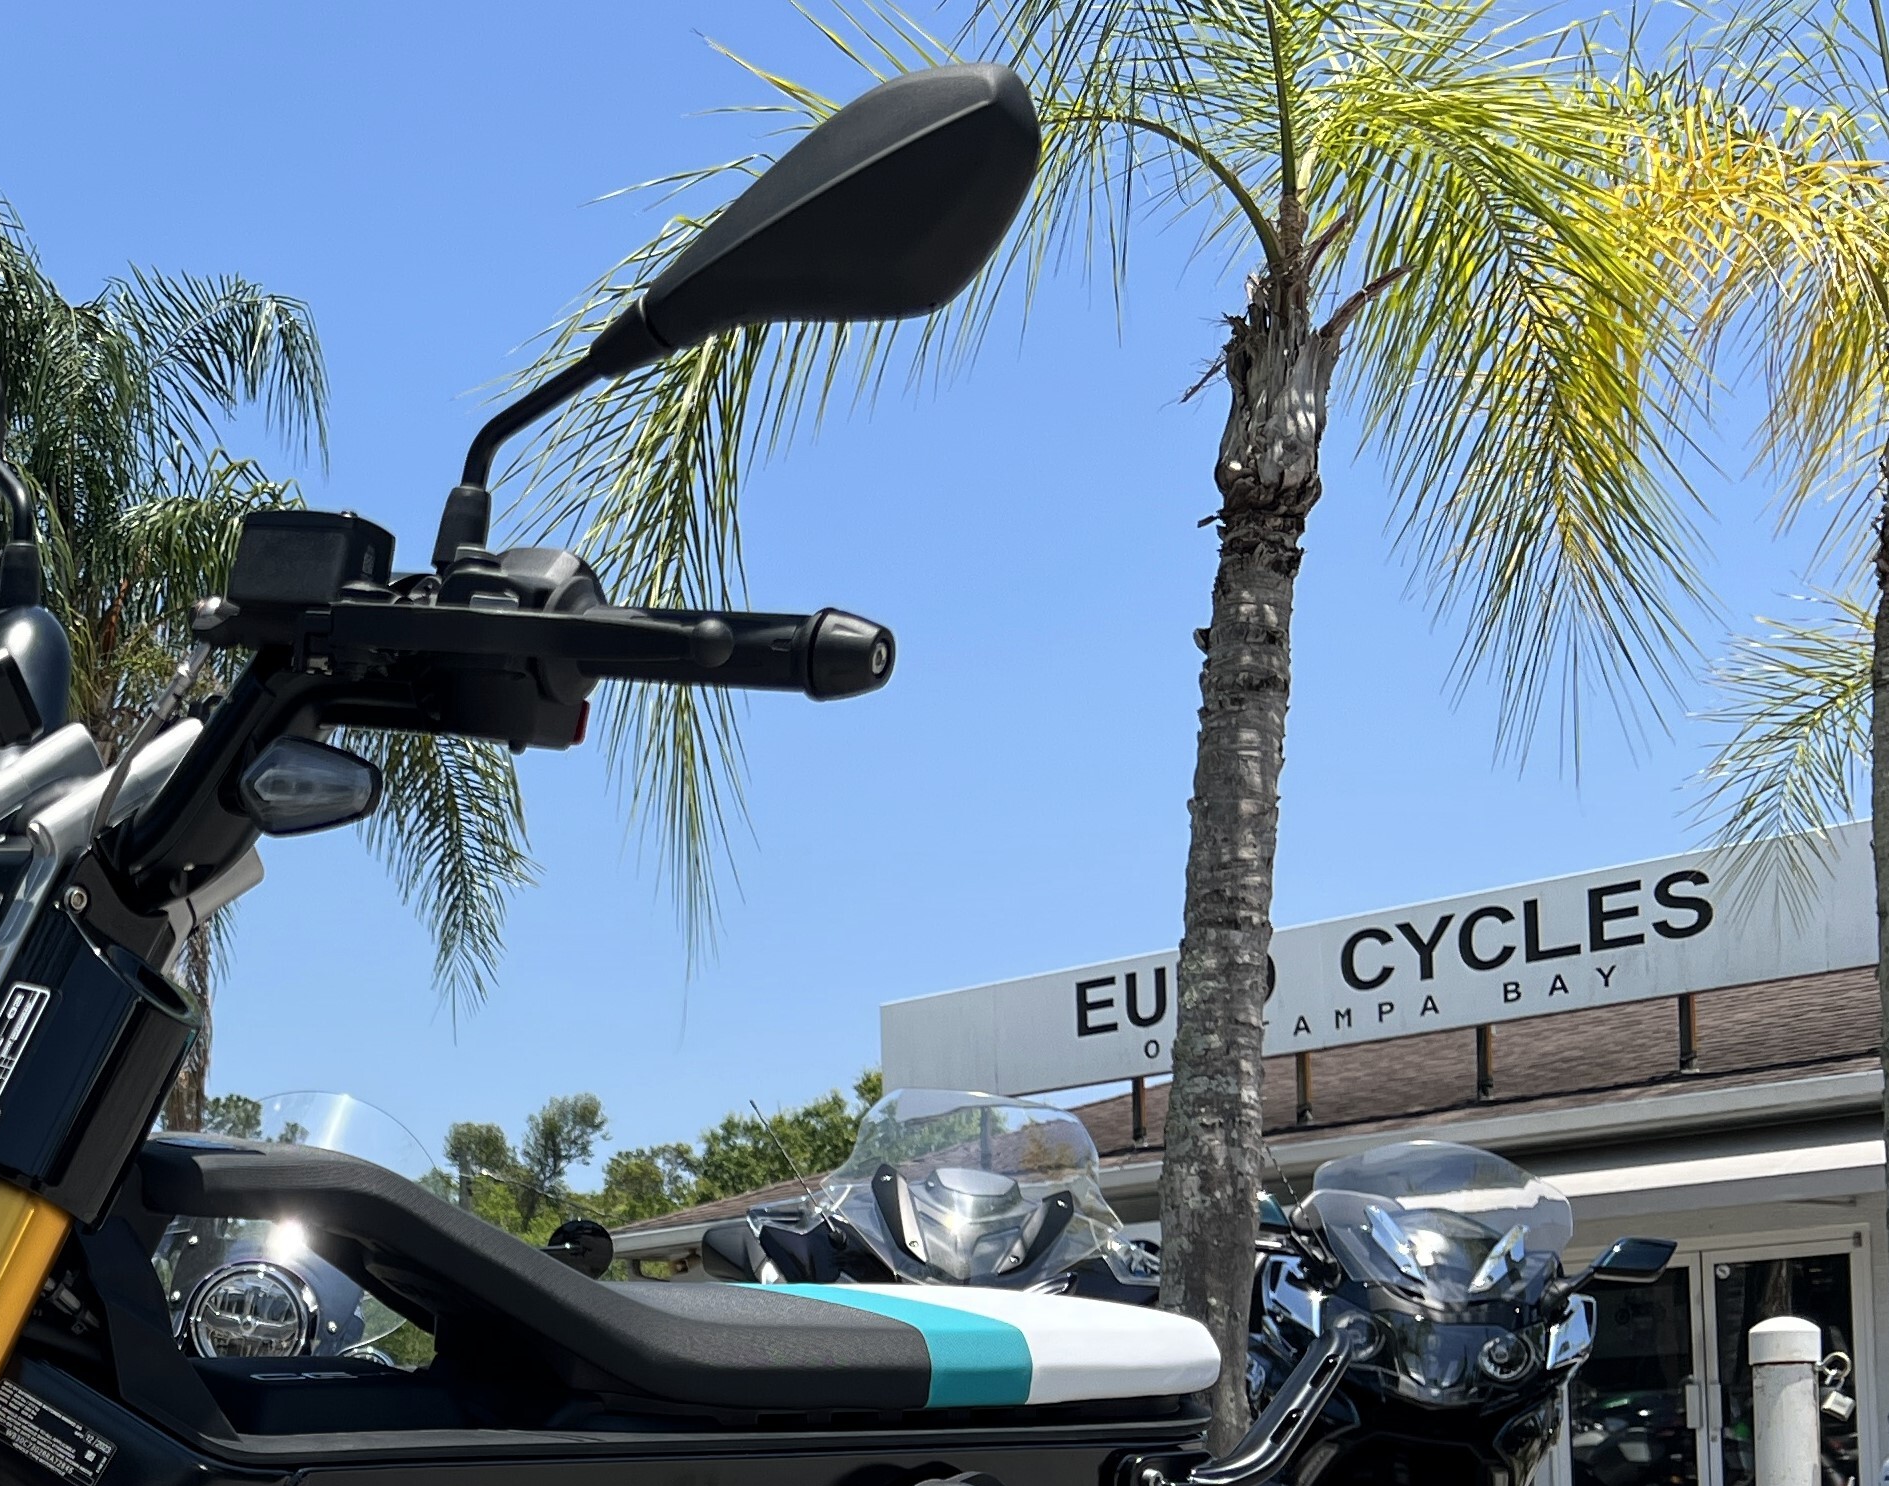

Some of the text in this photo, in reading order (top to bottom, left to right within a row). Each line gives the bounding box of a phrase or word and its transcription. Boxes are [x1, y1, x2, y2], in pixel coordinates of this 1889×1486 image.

[1076, 870, 1714, 1036] EU CYCLES
[1263, 996, 1440, 1037] AMPA
[1503, 965, 1617, 1003] BAY
